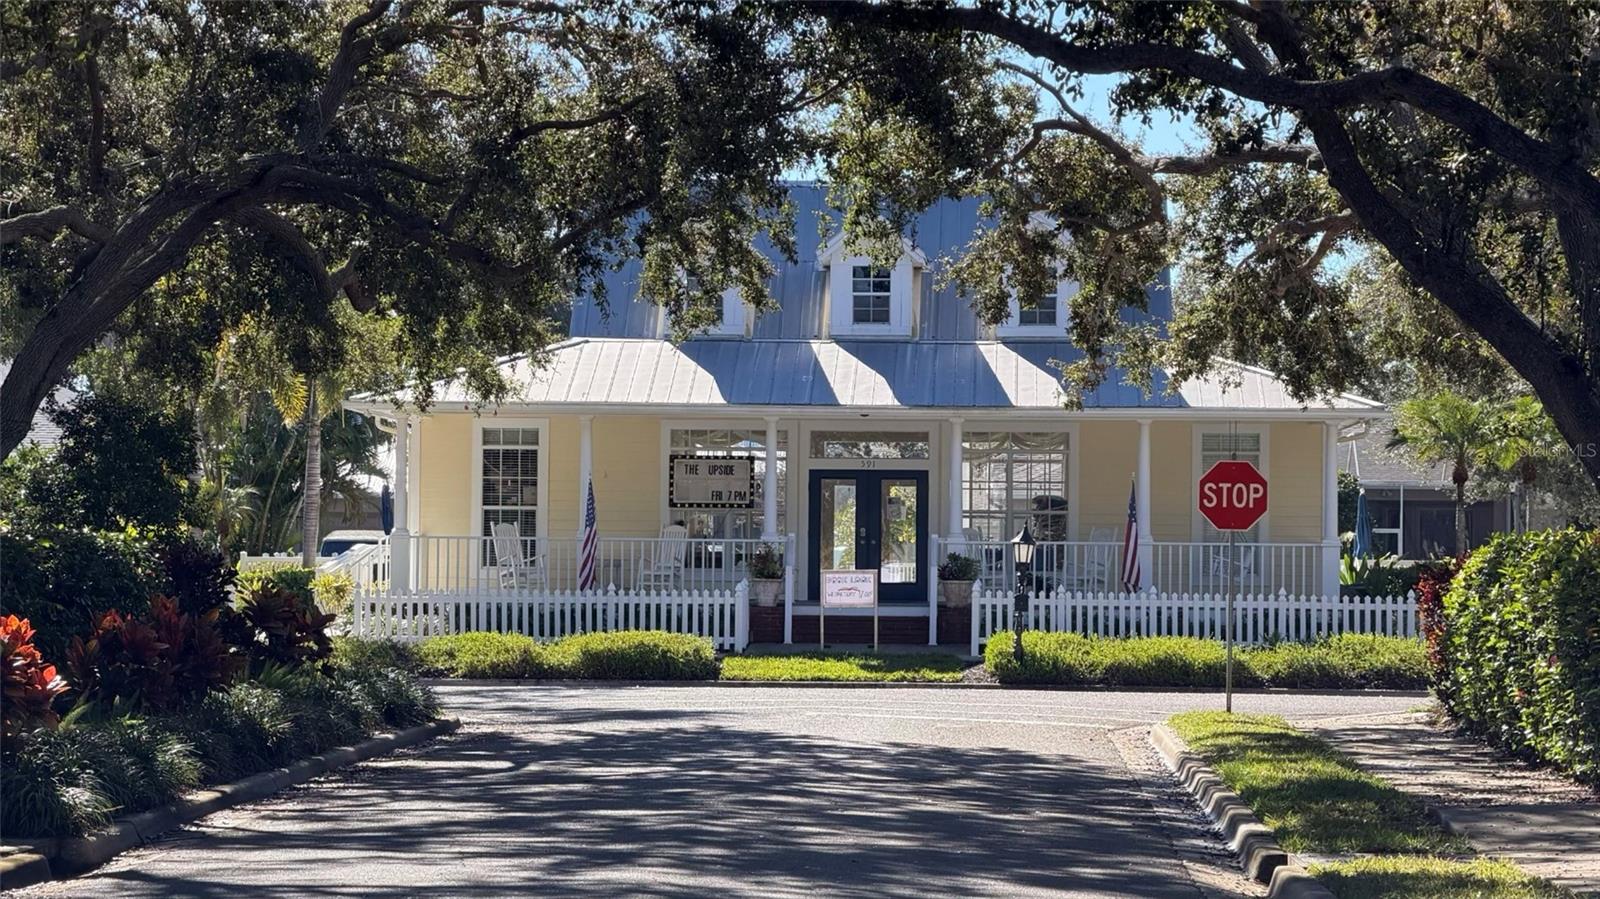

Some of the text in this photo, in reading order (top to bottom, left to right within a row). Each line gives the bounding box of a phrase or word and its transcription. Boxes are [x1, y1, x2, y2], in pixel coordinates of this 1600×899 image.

[684, 464, 735, 476] THE UPSIDE
[711, 490, 747, 501] FRI 7 PM
[1203, 482, 1264, 509] STOP
